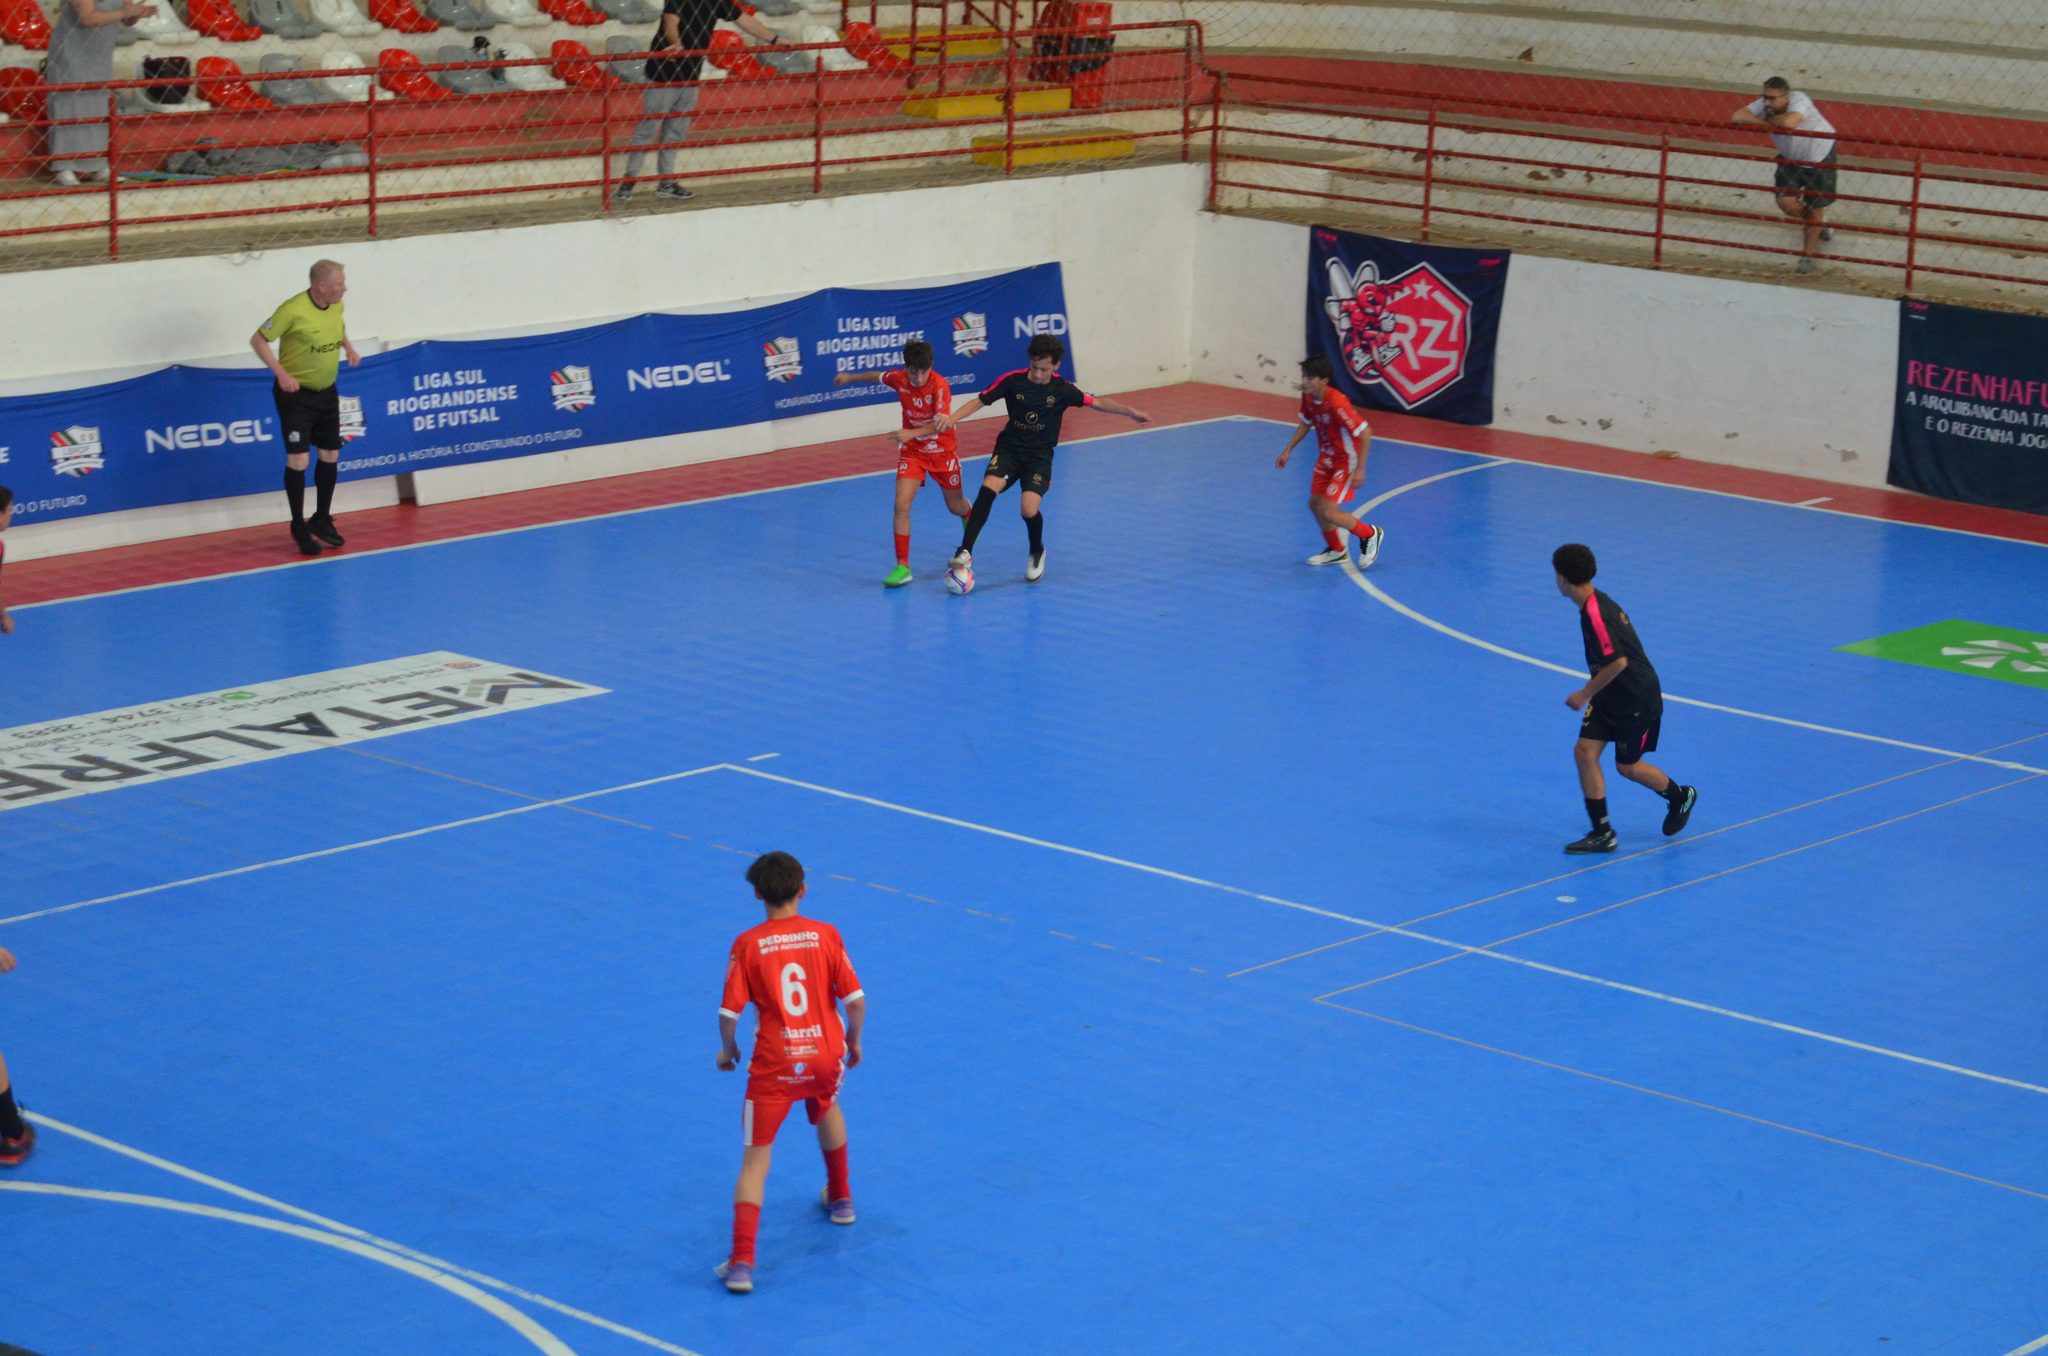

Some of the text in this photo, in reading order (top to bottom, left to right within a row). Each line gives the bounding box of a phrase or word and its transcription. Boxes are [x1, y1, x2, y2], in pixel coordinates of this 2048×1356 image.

[837, 316, 899, 333] LIGA SUL
[627, 359, 731, 392] NEDEL
[836, 357, 855, 372] DE
[414, 369, 487, 391] LIGA SUL
[944, 372, 976, 385] UTURO
[387, 384, 518, 416] RIOGRANDENSE
[774, 391, 823, 409] HONRANDO
[823, 391, 832, 400] A
[1905, 391, 1917, 405] A
[1920, 394, 2029, 425] ARQUIBANCADA
[413, 406, 500, 432] DE FUTSAL
[145, 418, 273, 454] NEDEL
[398, 452, 407, 463] A
[408, 444, 454, 461] HISTÓRIA
[454, 445, 462, 455] E
[461, 434, 533, 453] CONSTRUINDO
[534, 435, 543, 444] O
[545, 427, 582, 443] FUTURO
[1925, 416, 2048, 449] E O REZENHA JOG
[40, 494, 88, 511] FUTURO
[758, 931, 819, 948] PEDRINHO
[781, 962, 808, 1017] 6
